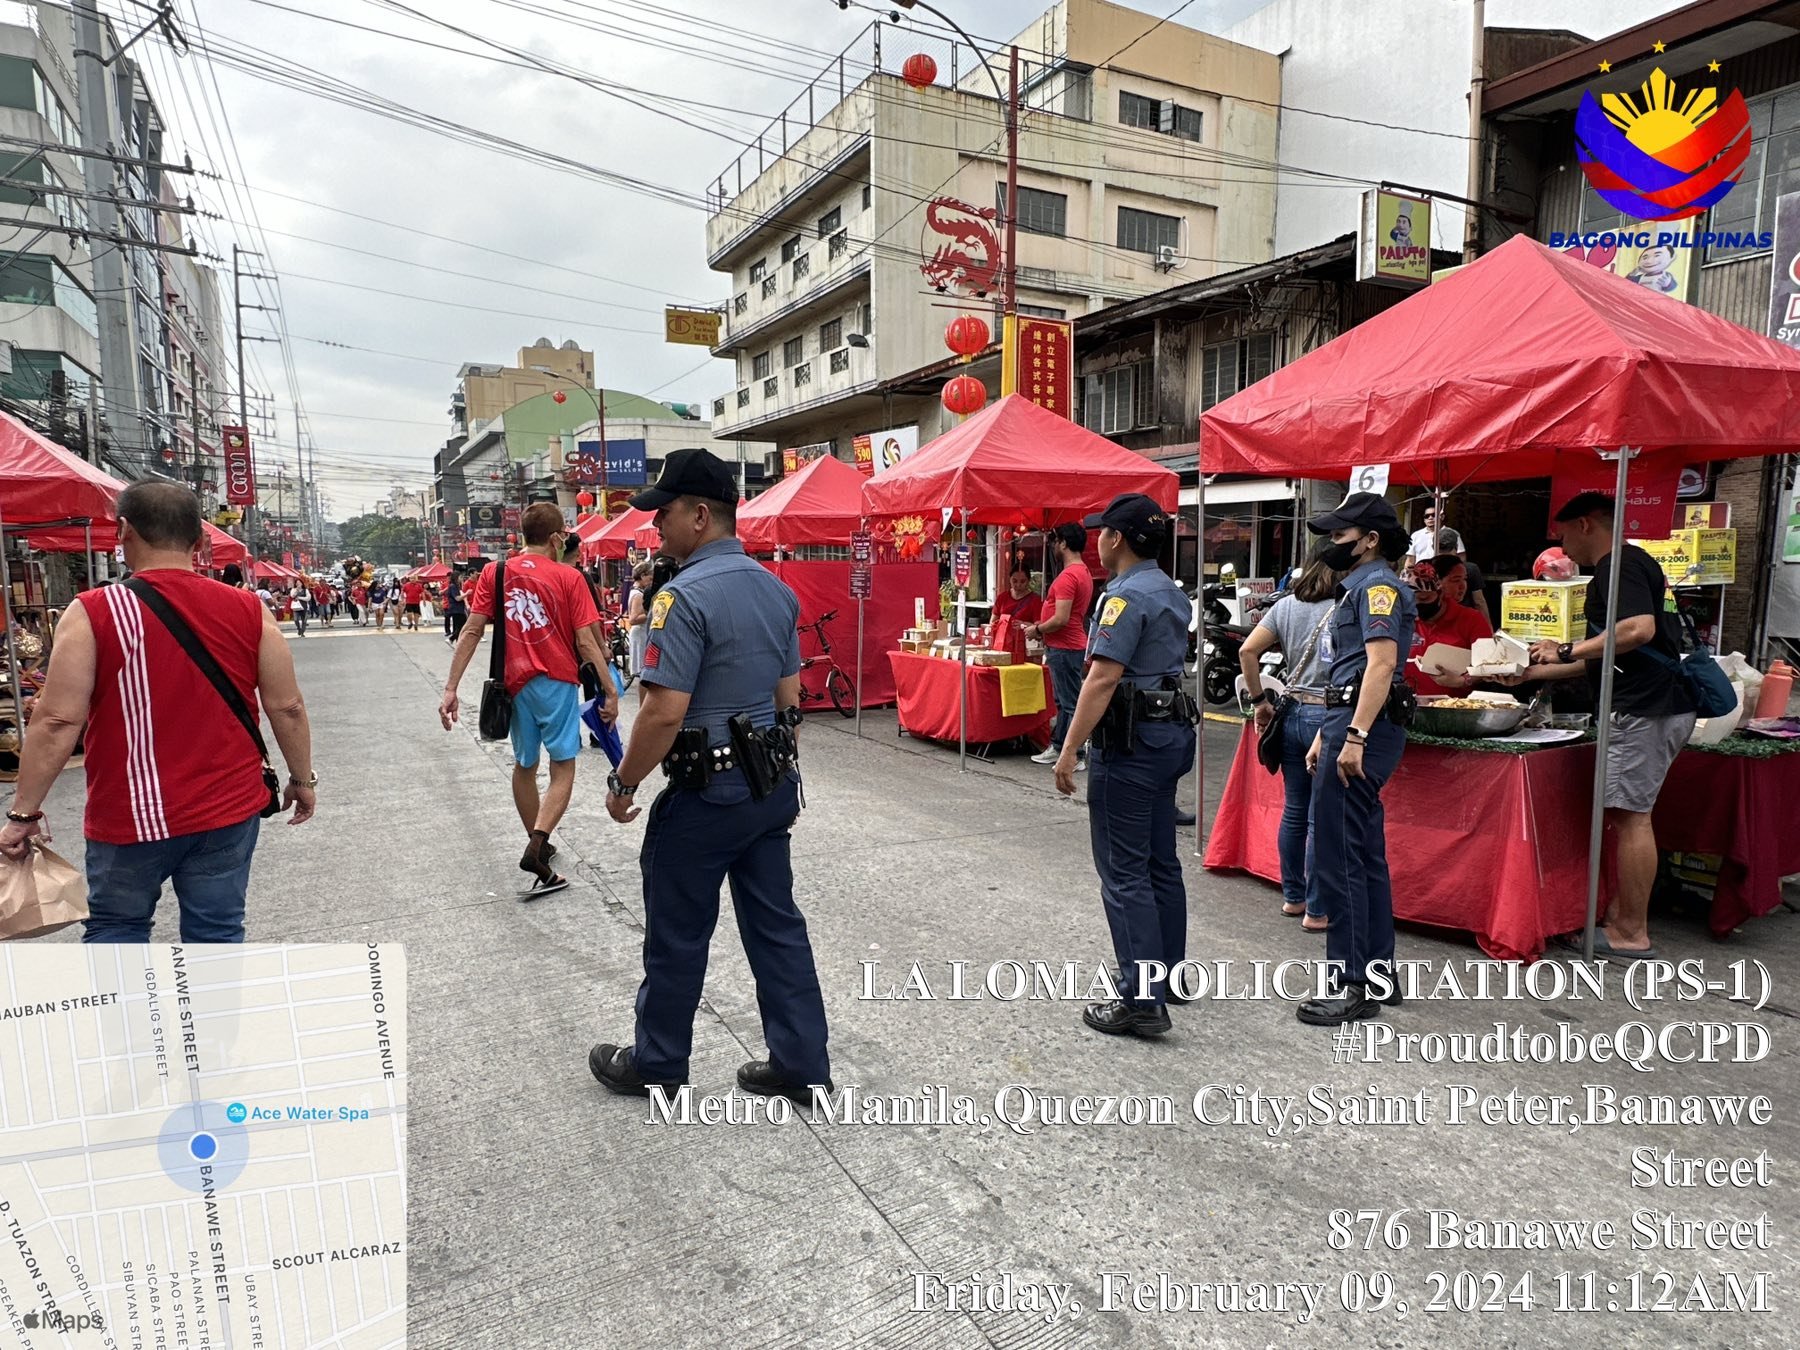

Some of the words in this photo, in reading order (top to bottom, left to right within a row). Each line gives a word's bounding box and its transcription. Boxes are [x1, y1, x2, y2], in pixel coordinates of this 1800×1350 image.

[1380, 246, 1427, 260] PALUTO
[1358, 466, 1375, 491] 6
[117, 548, 123, 556] 2
[1509, 612, 1557, 622] 8888-2005
